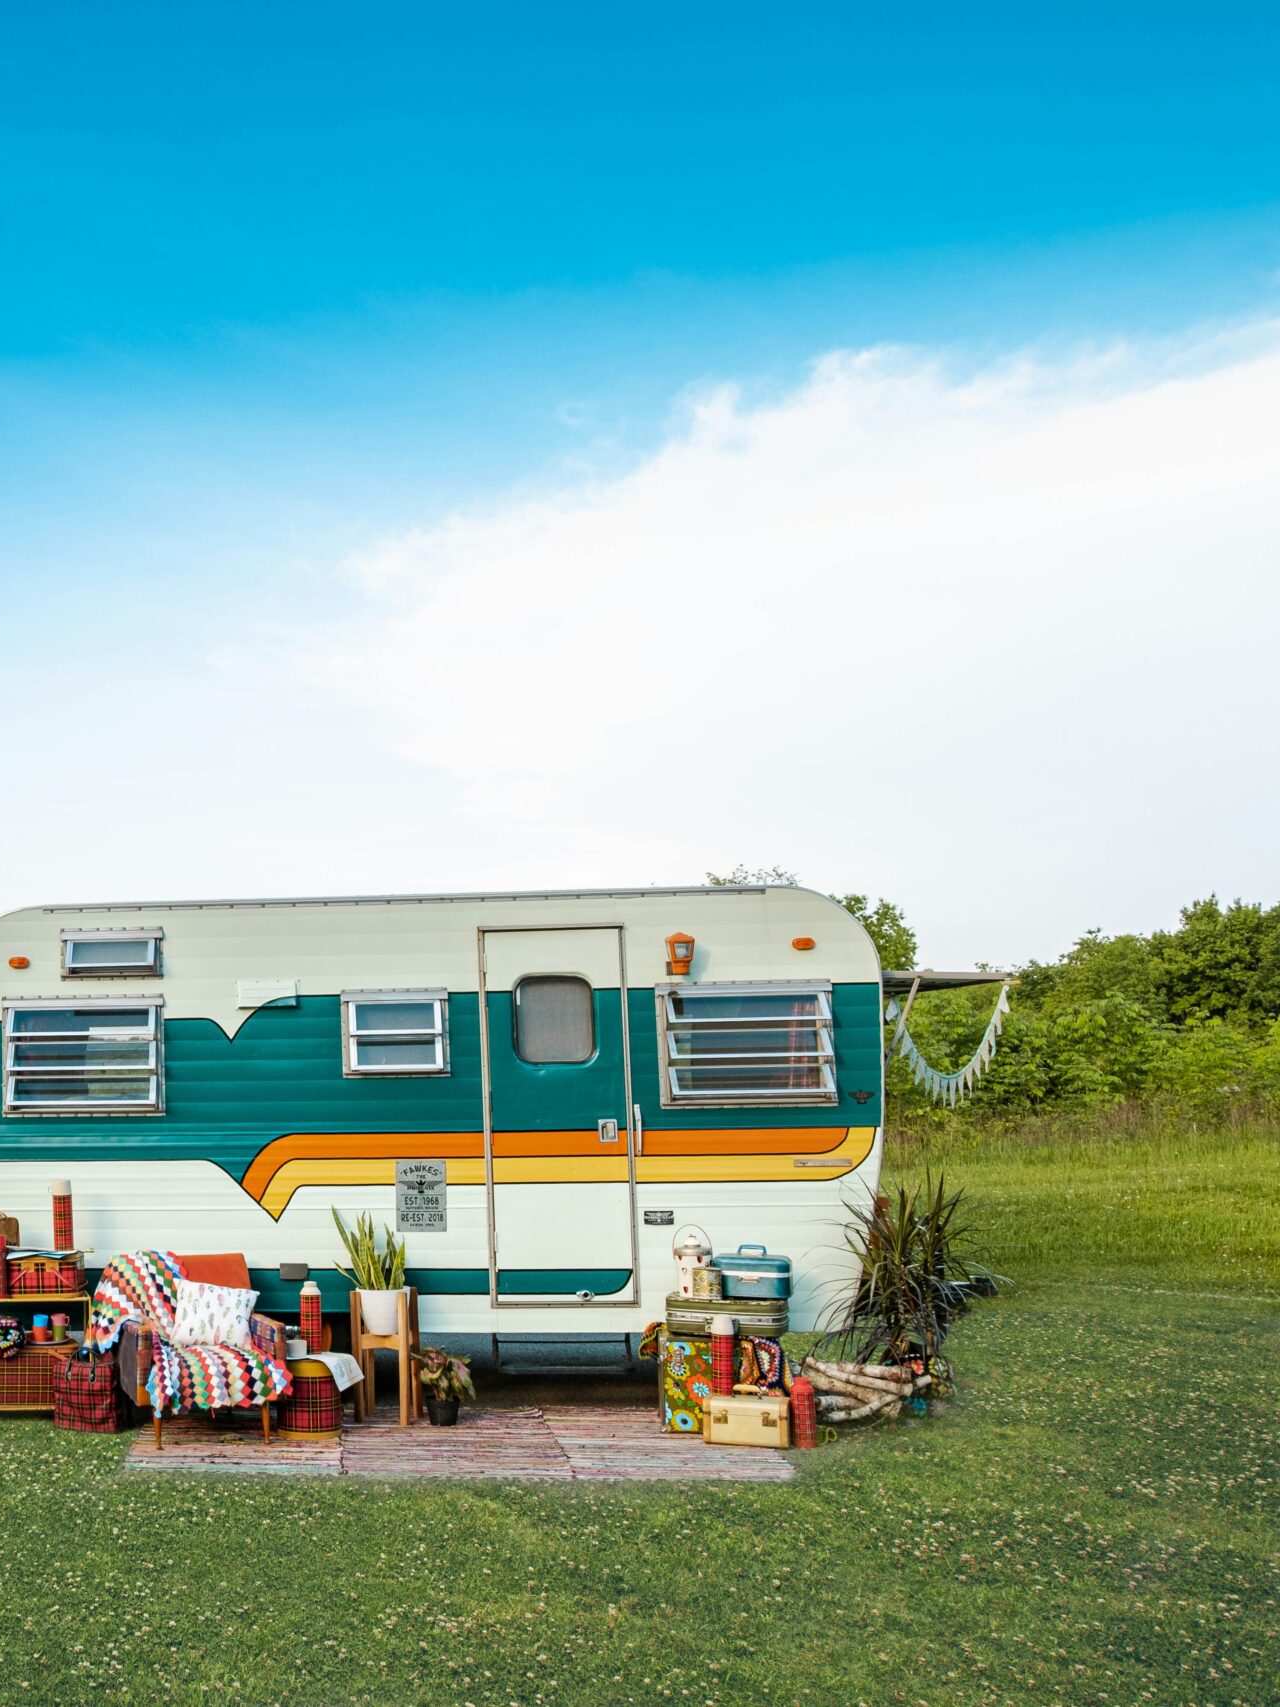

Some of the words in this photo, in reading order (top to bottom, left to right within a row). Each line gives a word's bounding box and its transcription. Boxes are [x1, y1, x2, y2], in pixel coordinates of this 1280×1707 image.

[422, 1196, 440, 1205] 1968
[401, 1213, 427, 1222] RE-EST.
[428, 1213, 444, 1222] 2018
